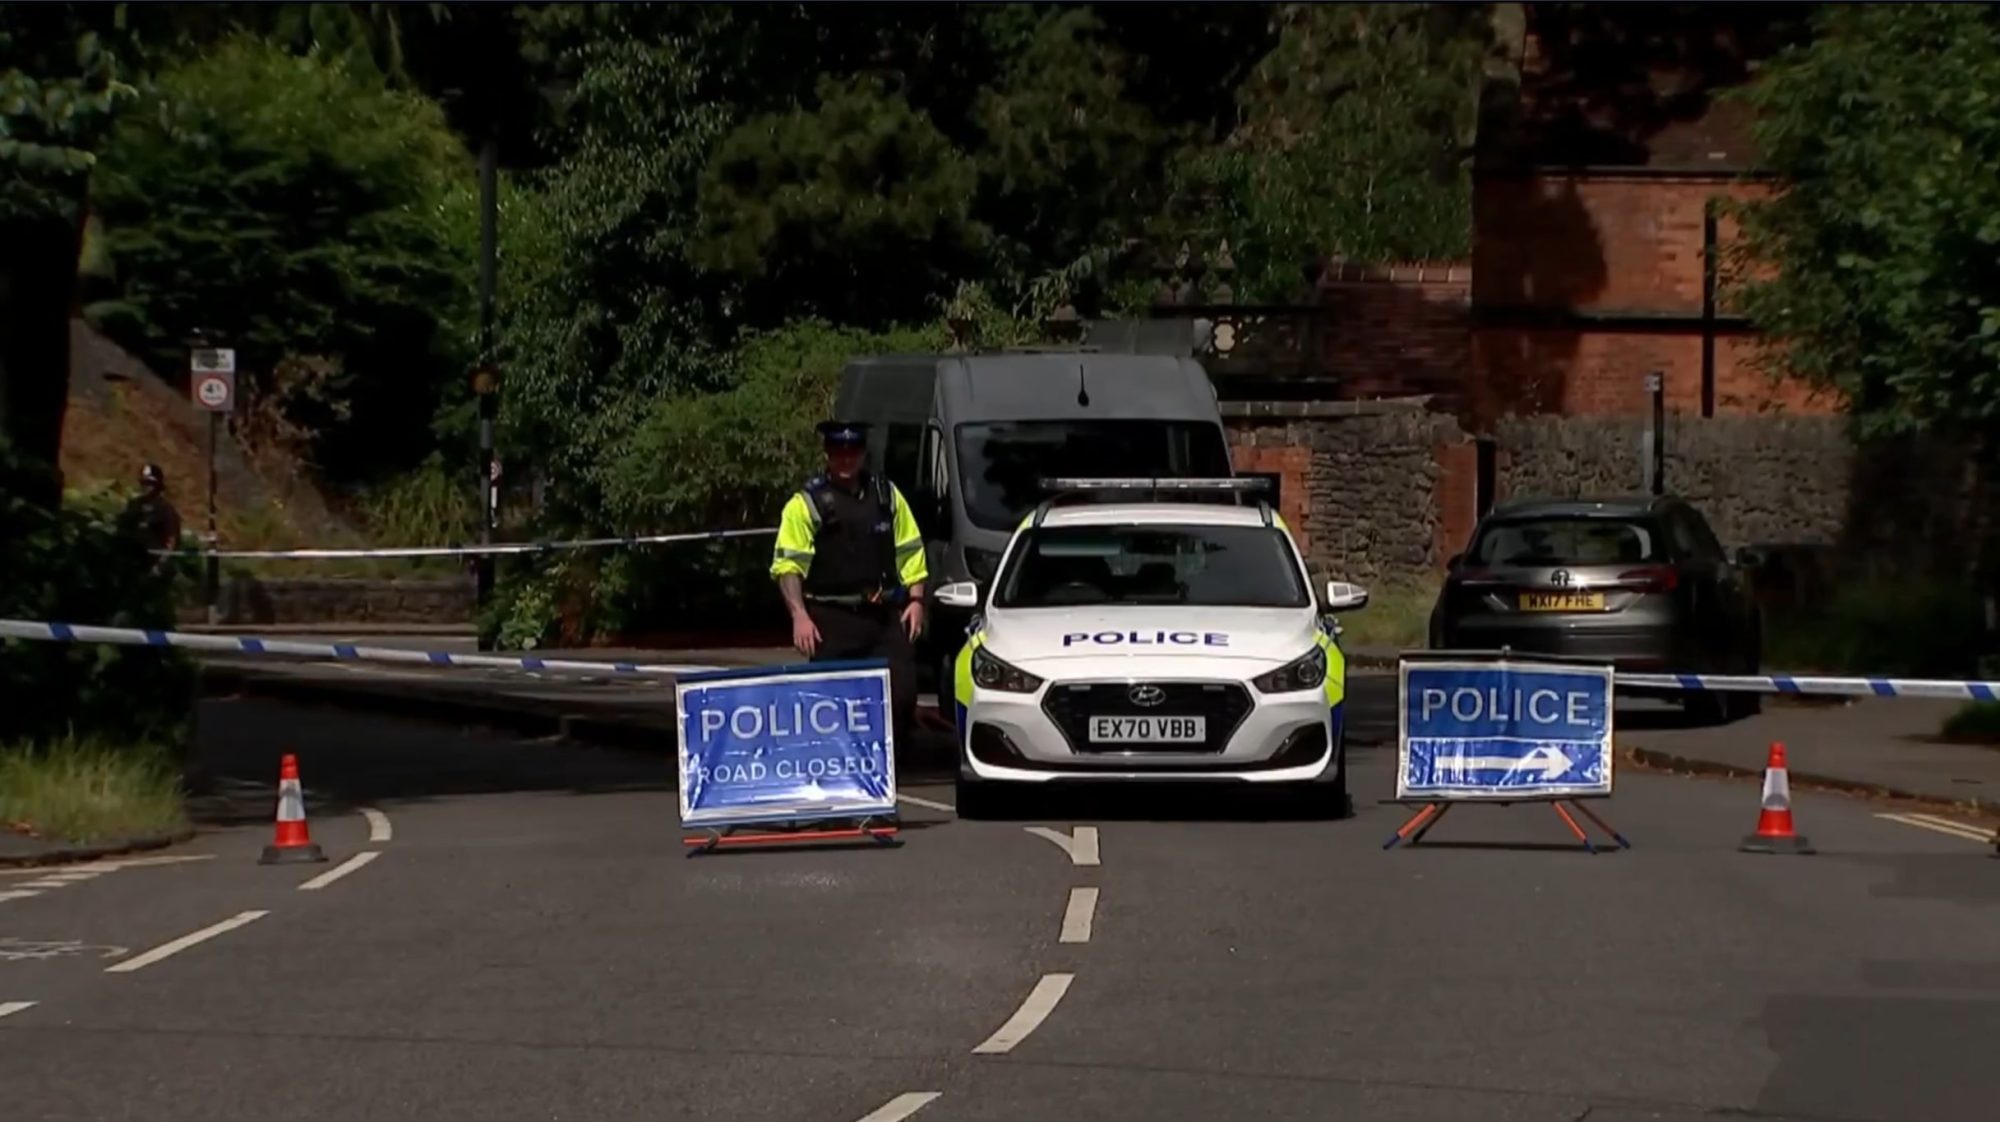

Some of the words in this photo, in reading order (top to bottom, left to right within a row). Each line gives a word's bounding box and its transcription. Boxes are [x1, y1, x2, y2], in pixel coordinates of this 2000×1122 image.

[1062, 631, 1230, 647] POLICE
[1422, 687, 1590, 725] POLICE
[701, 699, 872, 743] POLICE
[1097, 719, 1150, 738] EX70
[1157, 719, 1197, 738] VBB
[700, 763, 767, 784] ROAD
[776, 757, 877, 779] CLOSED
